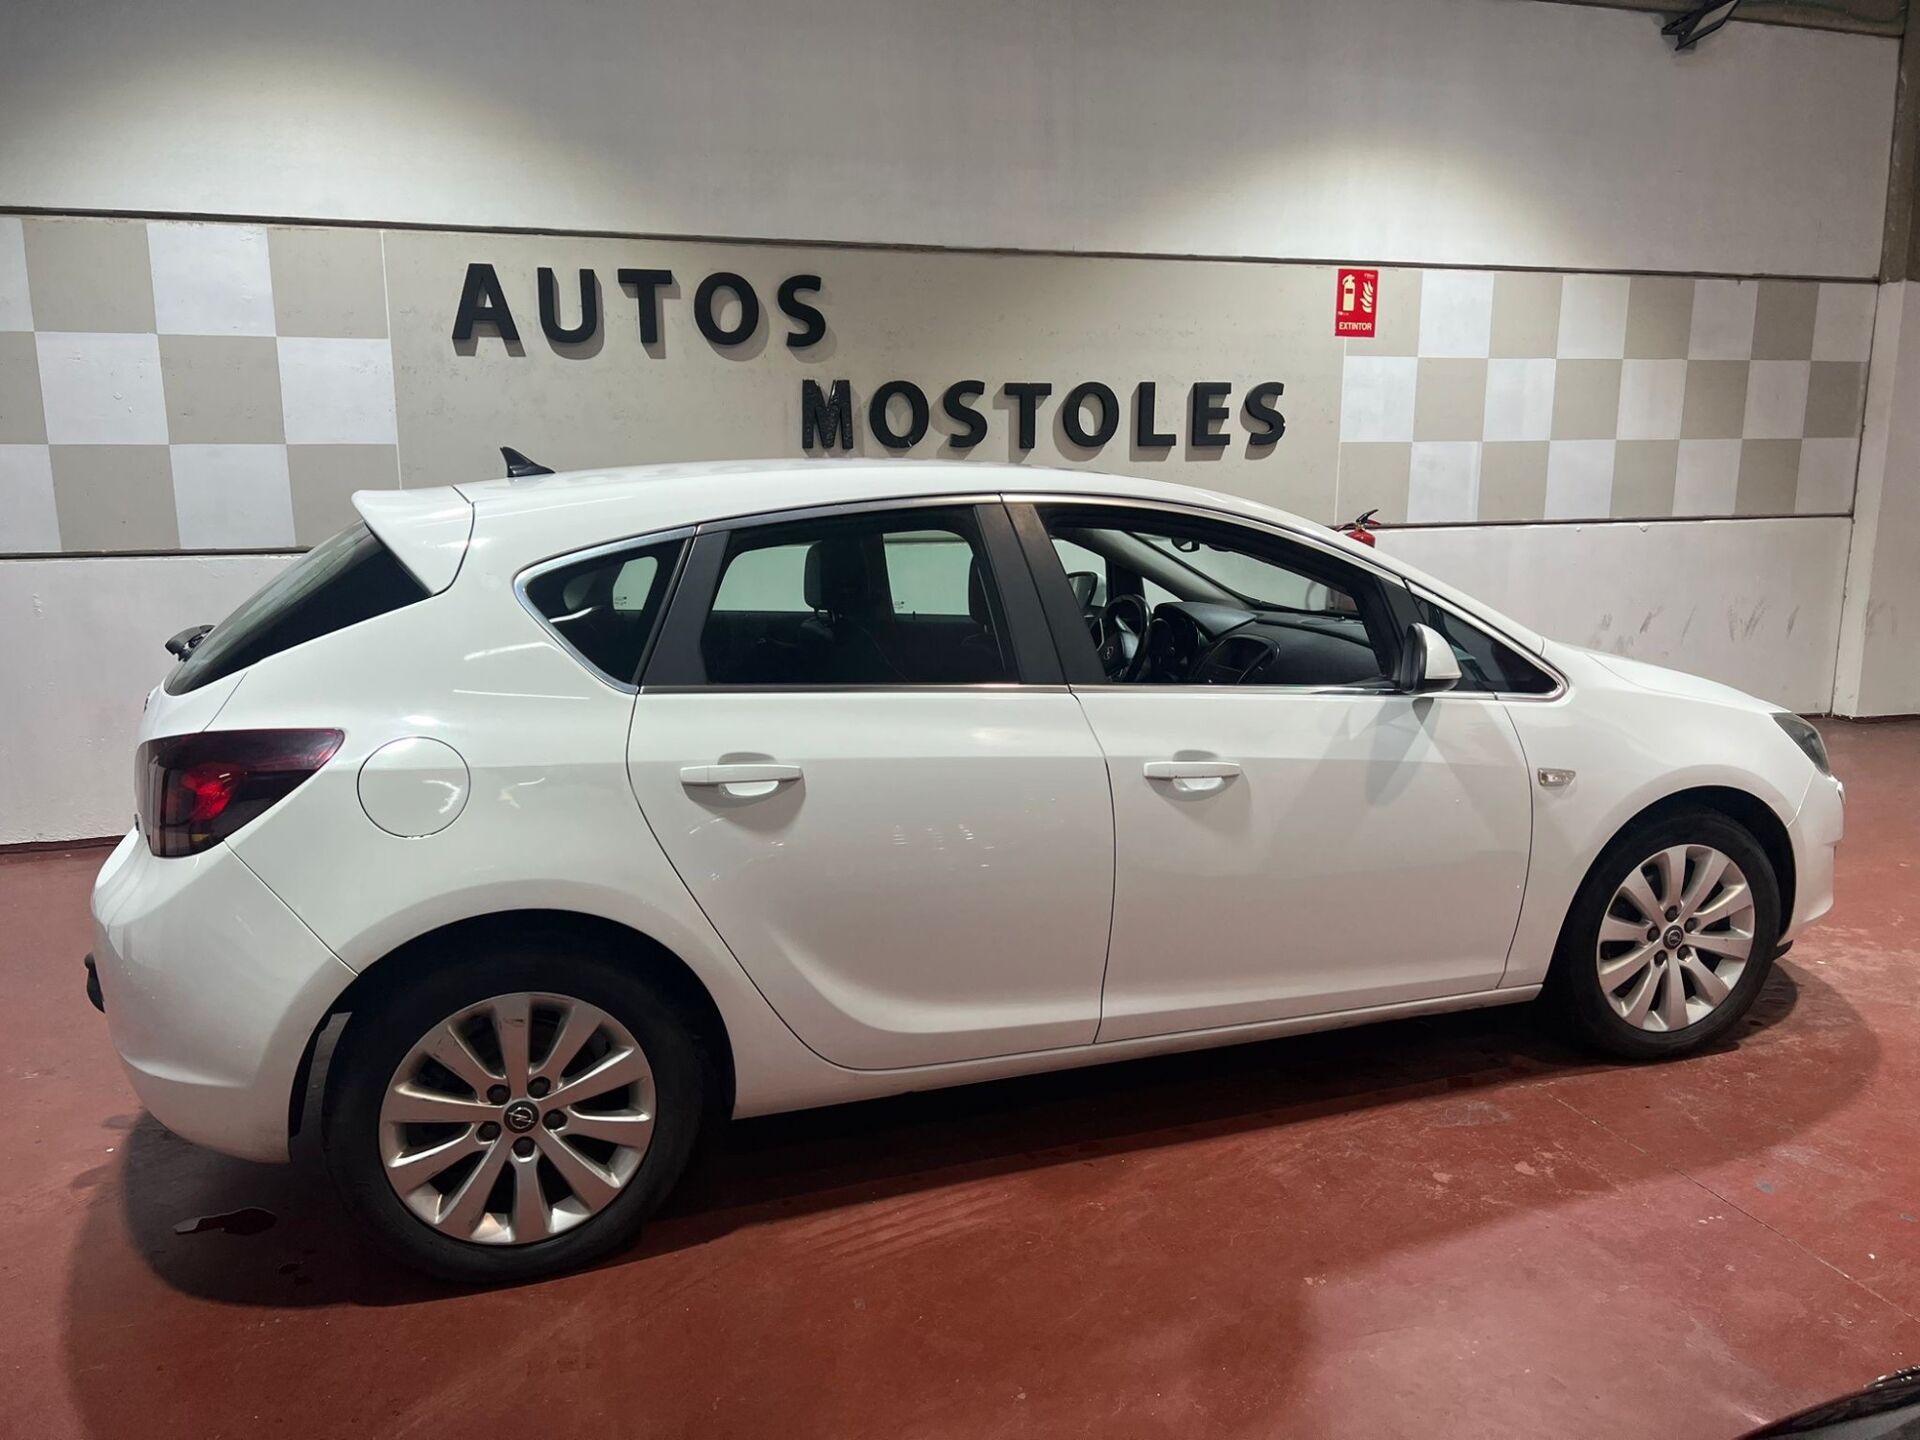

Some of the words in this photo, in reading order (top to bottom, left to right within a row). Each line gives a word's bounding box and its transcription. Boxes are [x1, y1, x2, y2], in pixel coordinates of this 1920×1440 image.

[452, 263, 826, 347] AUTOS
[1338, 321, 1373, 331] EXTINTOR
[802, 379, 1286, 450] MOSTOLES
